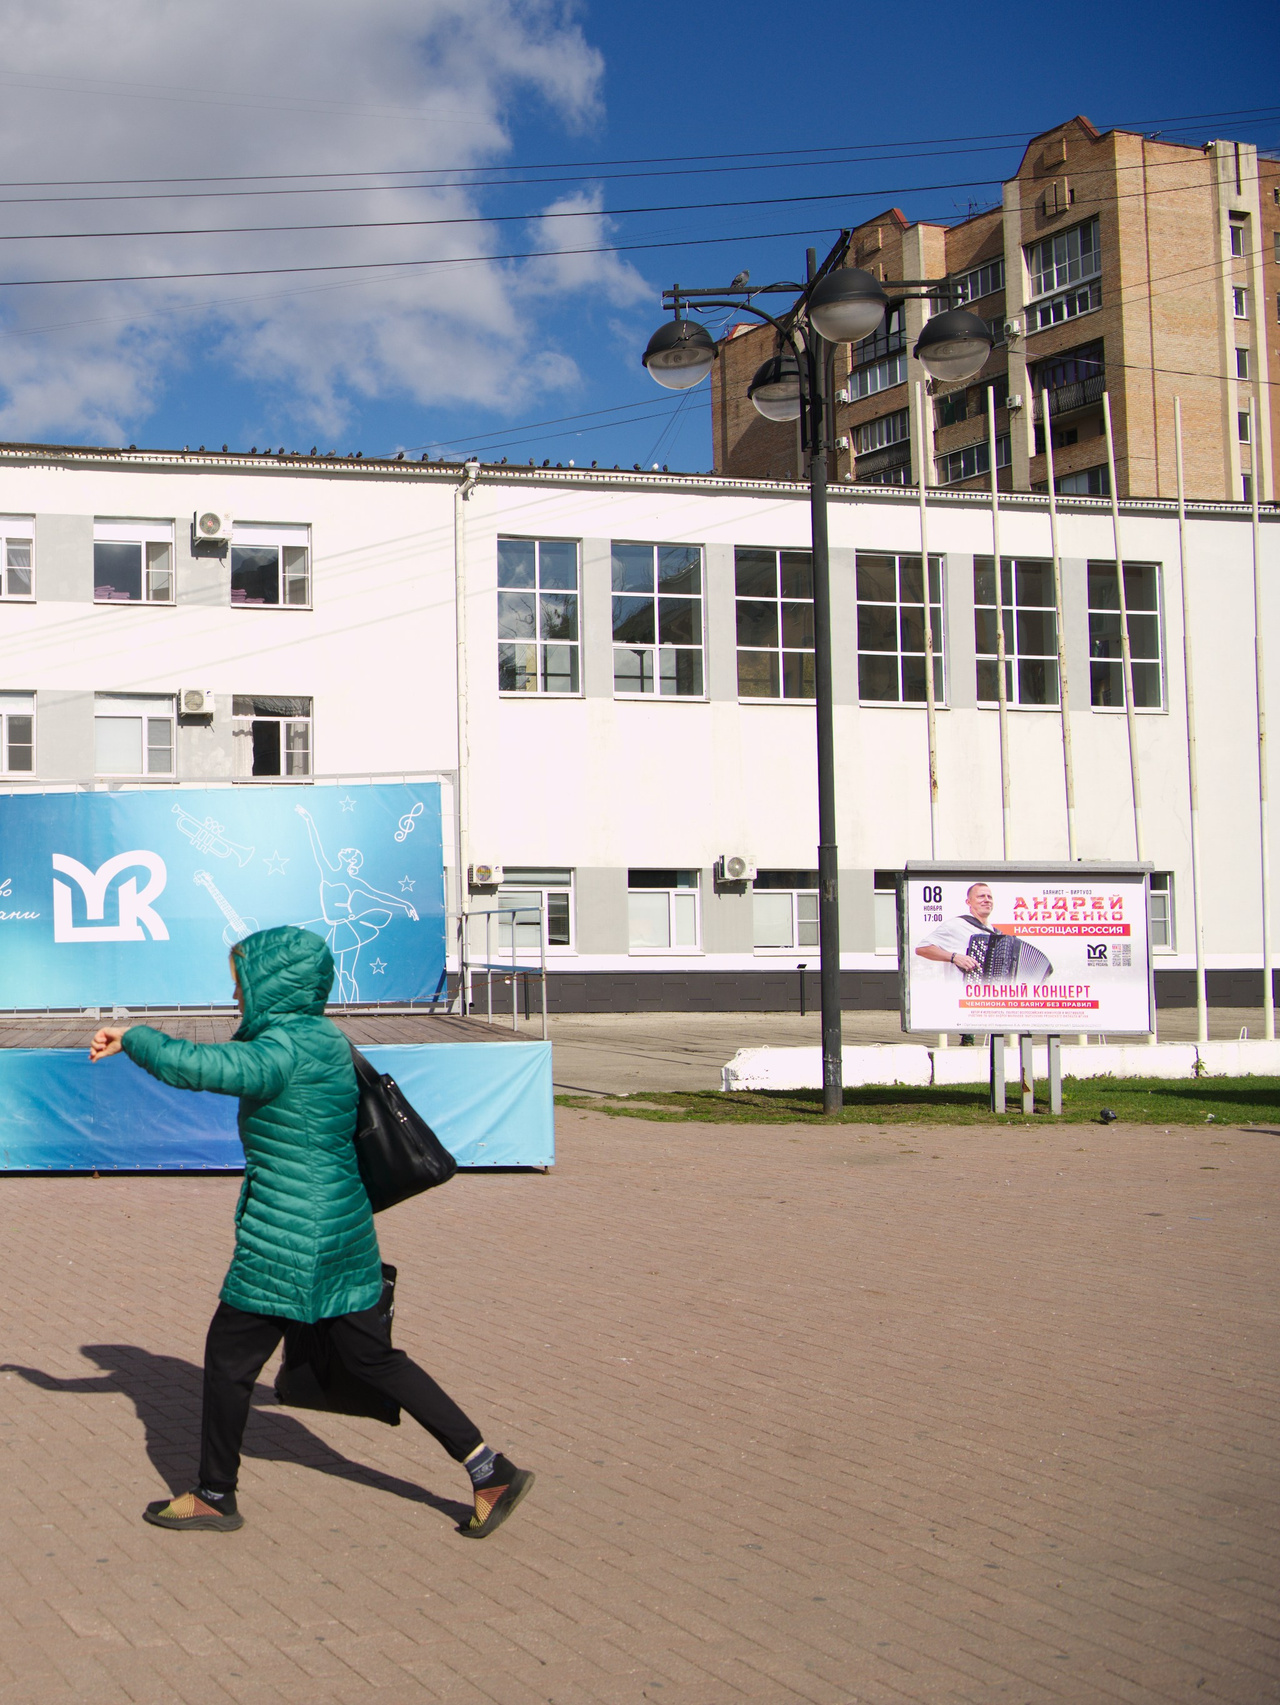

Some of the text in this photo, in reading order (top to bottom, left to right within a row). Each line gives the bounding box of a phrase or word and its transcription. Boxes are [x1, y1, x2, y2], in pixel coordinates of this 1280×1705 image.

[923, 885, 943, 903] 08
[1013, 894, 1124, 912] АНДРЕЙ
[923, 913, 943, 922] 17:00
[1013, 911, 1124, 921] КИРИЕНКО
[1014, 926, 1124, 935] НАСТОЯЩАЯ РОССИЯ
[965, 983, 1091, 999] СОЛЬНЫЙ КОНЦЕРТ
